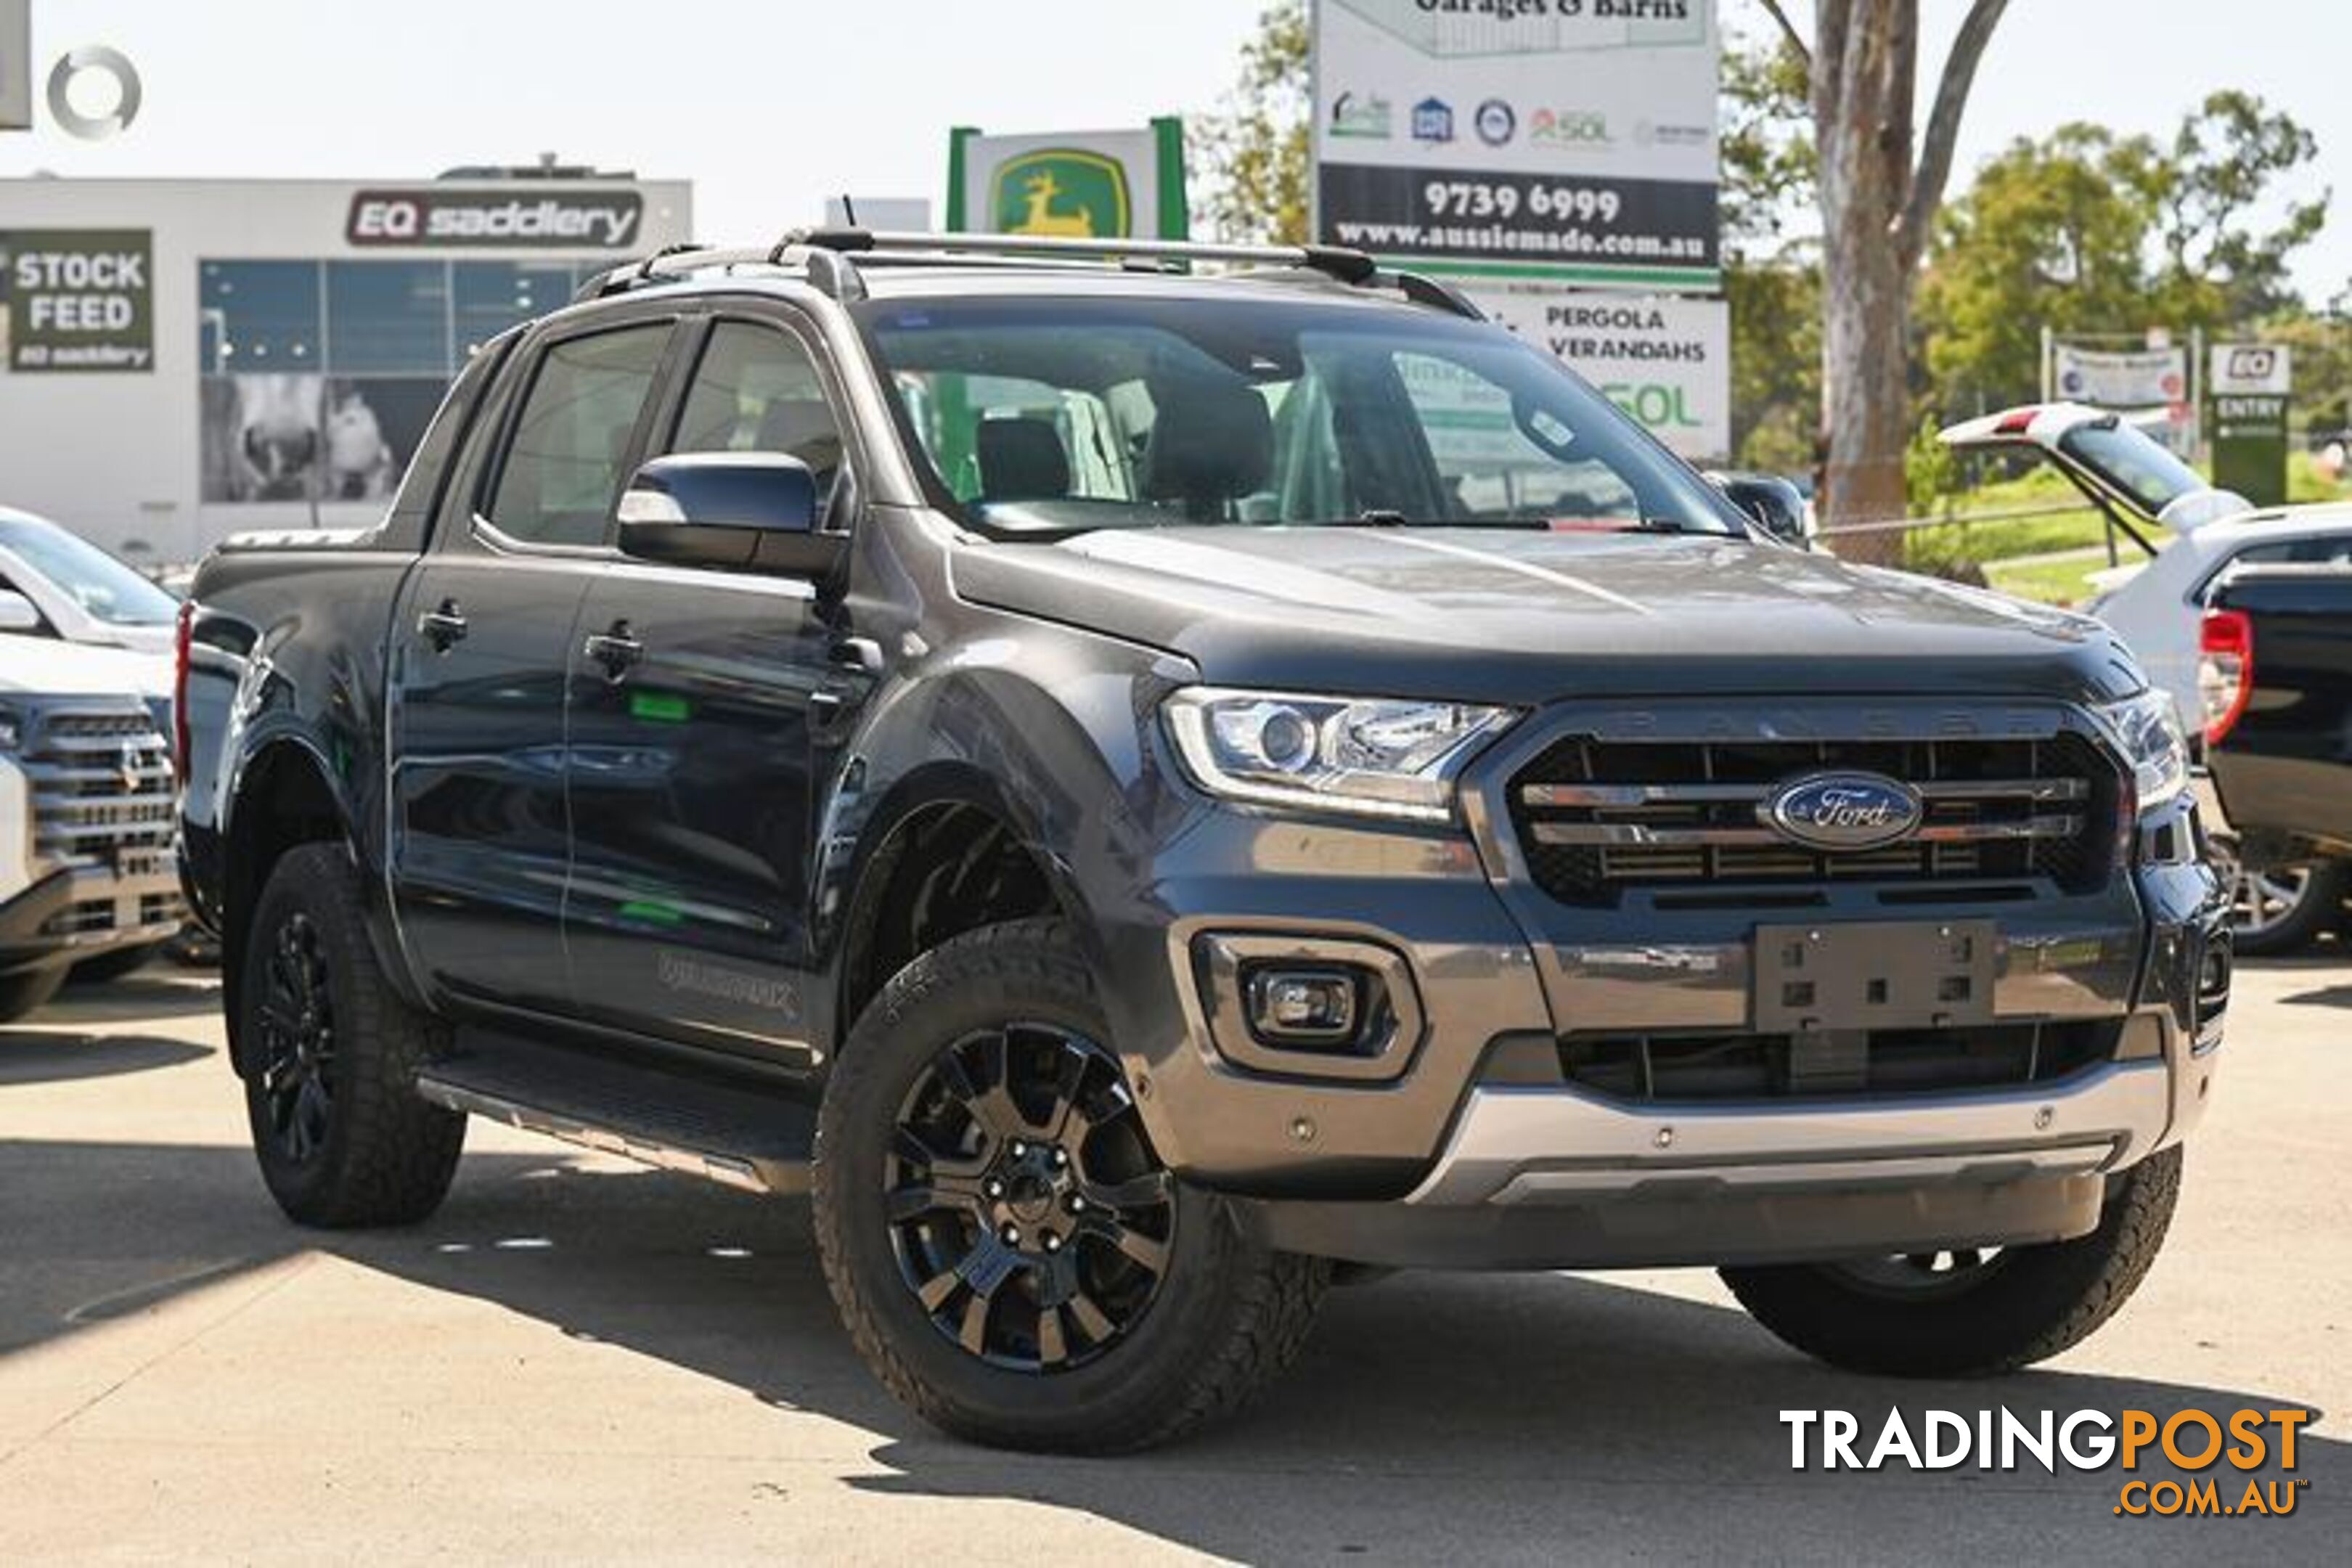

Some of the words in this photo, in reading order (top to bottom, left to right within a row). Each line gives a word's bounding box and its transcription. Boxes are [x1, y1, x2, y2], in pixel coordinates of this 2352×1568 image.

[1426, 182, 1518, 216] 9739
[1530, 187, 1620, 221] 6999
[356, 202, 417, 235] EQ
[428, 200, 634, 243] saddlery
[1336, 222, 1704, 256] www.aussiemade.com.au
[15, 254, 144, 288] STOCK
[30, 296, 132, 330] FEED
[1547, 306, 1664, 330] PERGOLA
[1550, 338, 1705, 362] VERANDAHS
[2217, 399, 2283, 417] ENTRY
[1815, 789, 1889, 826] Ford
